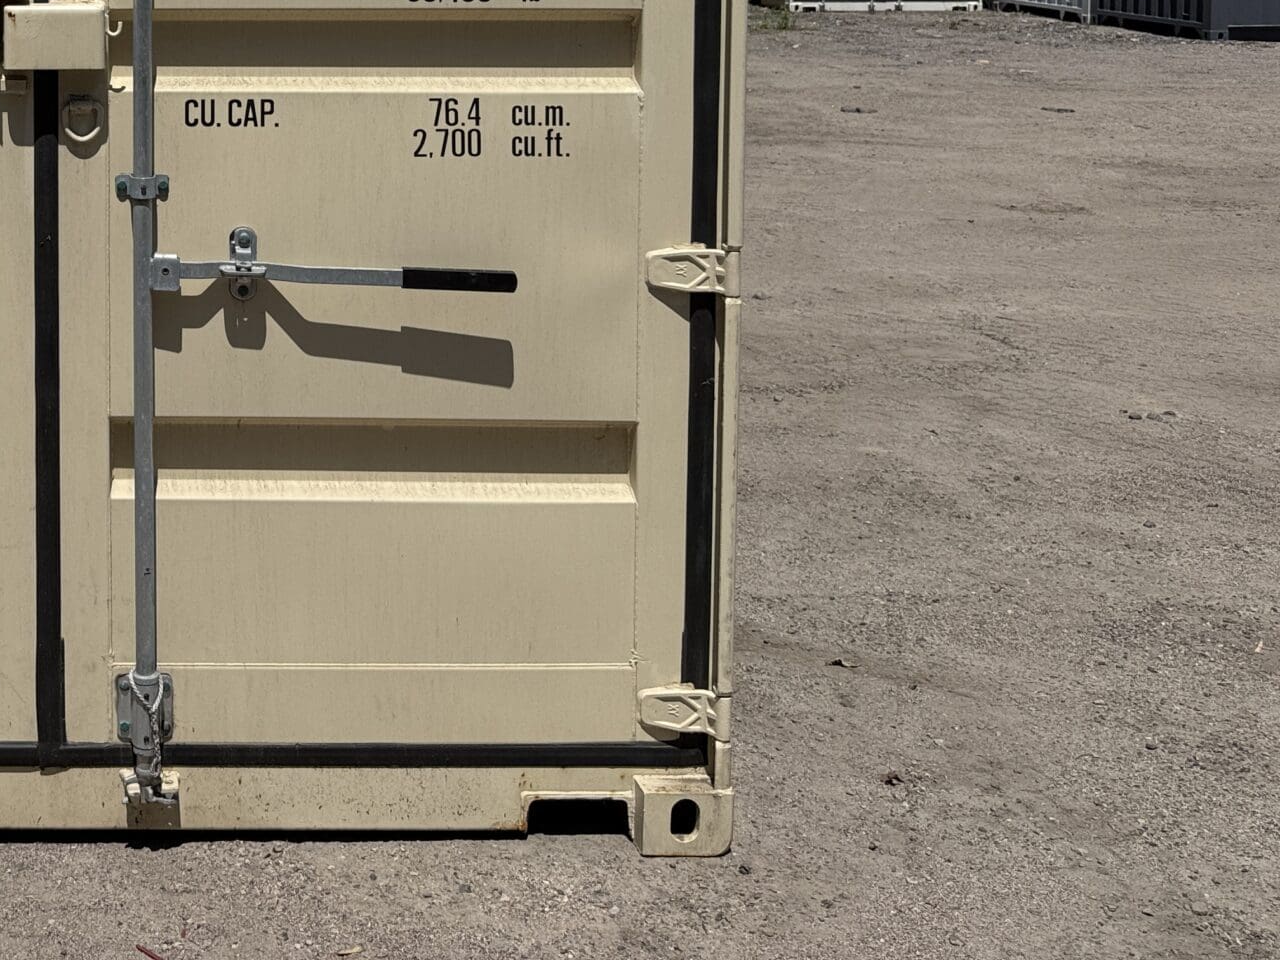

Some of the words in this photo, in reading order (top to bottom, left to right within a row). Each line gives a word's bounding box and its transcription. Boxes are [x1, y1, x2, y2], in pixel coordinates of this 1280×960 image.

[429, 97, 482, 127] 76.4
[511, 103, 571, 127] cu.m.
[413, 129, 482, 159] 2,700
[511, 128, 571, 158] cu.ft.
